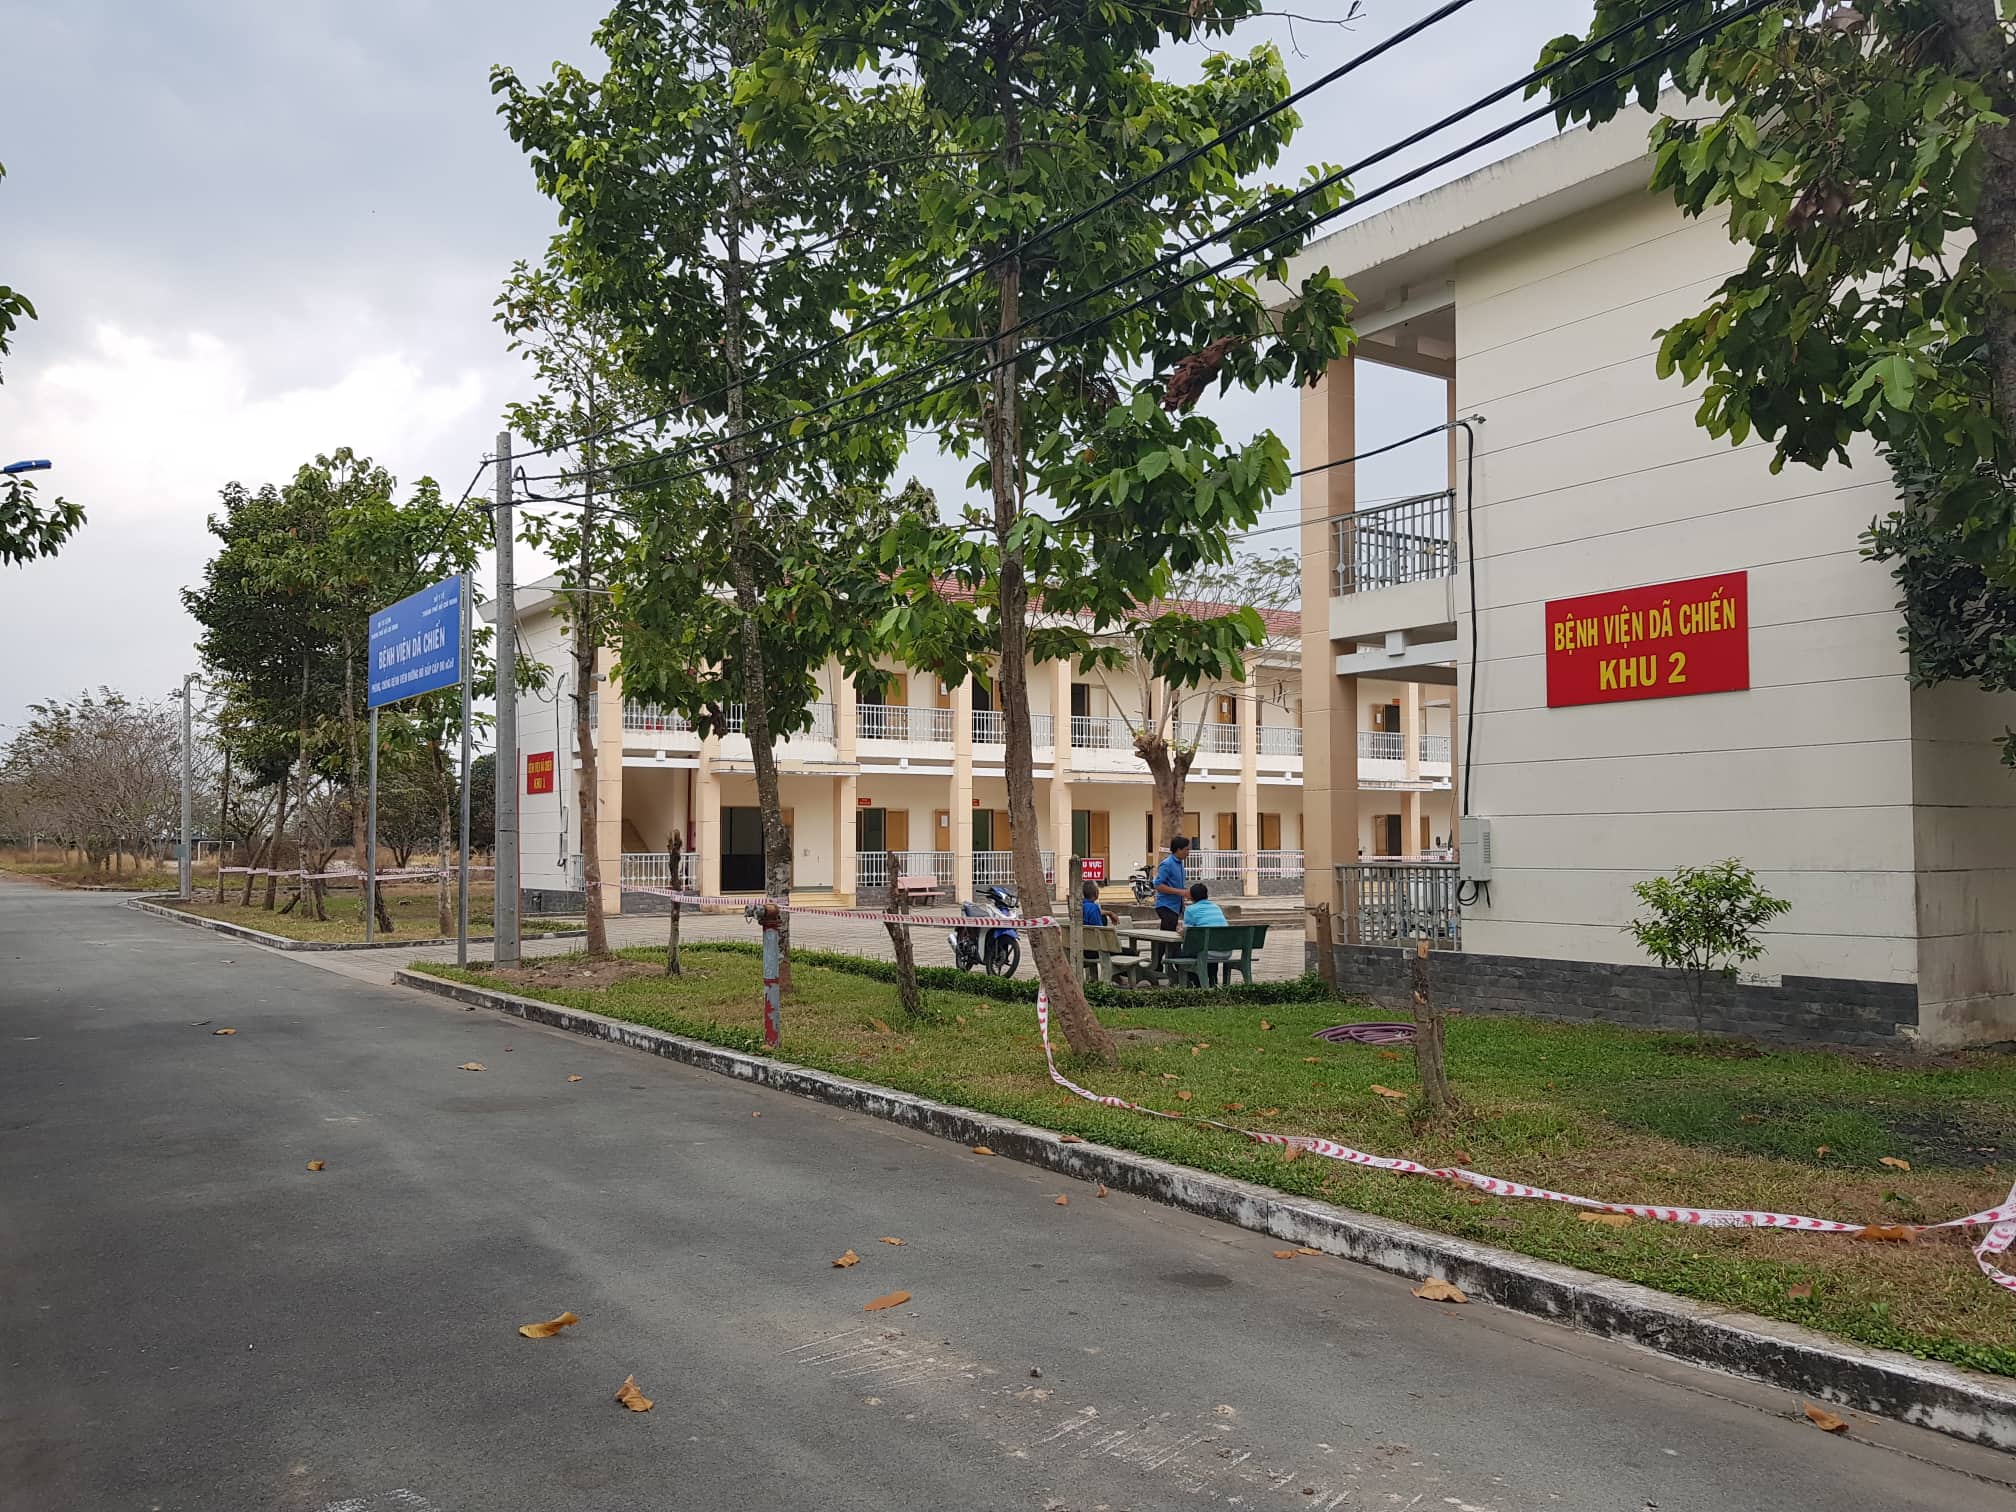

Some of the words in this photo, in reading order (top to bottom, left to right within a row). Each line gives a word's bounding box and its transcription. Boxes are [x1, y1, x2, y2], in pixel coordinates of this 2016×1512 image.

[378, 645, 395, 672] BỆNH
[396, 636, 411, 664] VIỆN
[412, 631, 421, 657] DÃ
[423, 619, 445, 653] CHIẾN
[1554, 613, 1598, 655] BỆNH
[1603, 605, 1643, 648] VIỆN
[1649, 599, 1673, 639] DÃ
[1679, 586, 1736, 635] CHIẾN
[1599, 655, 1657, 690] KHU
[1668, 651, 1686, 683] 2
